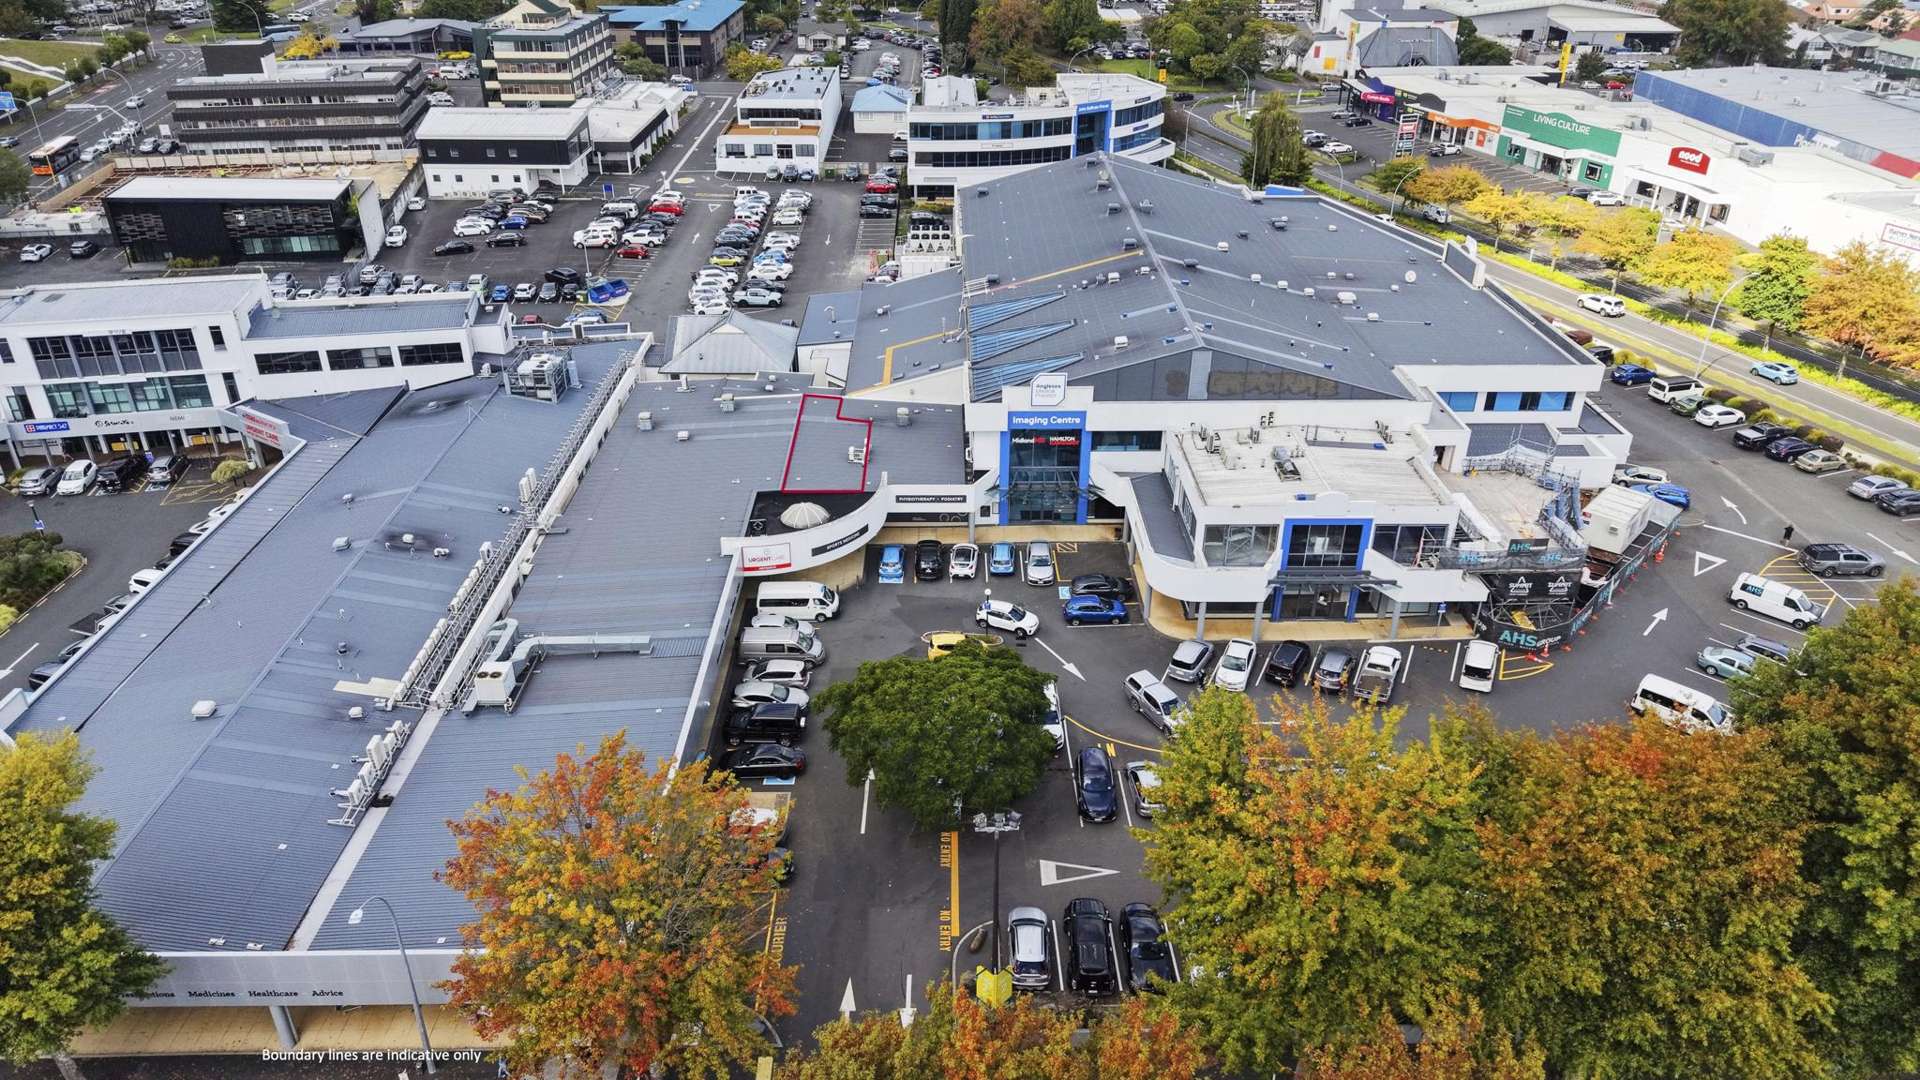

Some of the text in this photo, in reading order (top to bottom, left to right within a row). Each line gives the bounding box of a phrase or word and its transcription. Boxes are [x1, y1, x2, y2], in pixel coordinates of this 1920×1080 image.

[1533, 113, 1591, 136] LIVING CULTURE
[1678, 150, 1704, 163] nood
[1012, 415, 1081, 426] Imaging Centre
[1510, 543, 1531, 552] AHS
[1499, 630, 1537, 647] AHS
[940, 844, 951, 868] ENTRY
[940, 910, 951, 952] NO ENTRY
[188, 990, 236, 998] Medicines
[248, 990, 299, 998] Healthcare
[312, 990, 344, 998] Advice
